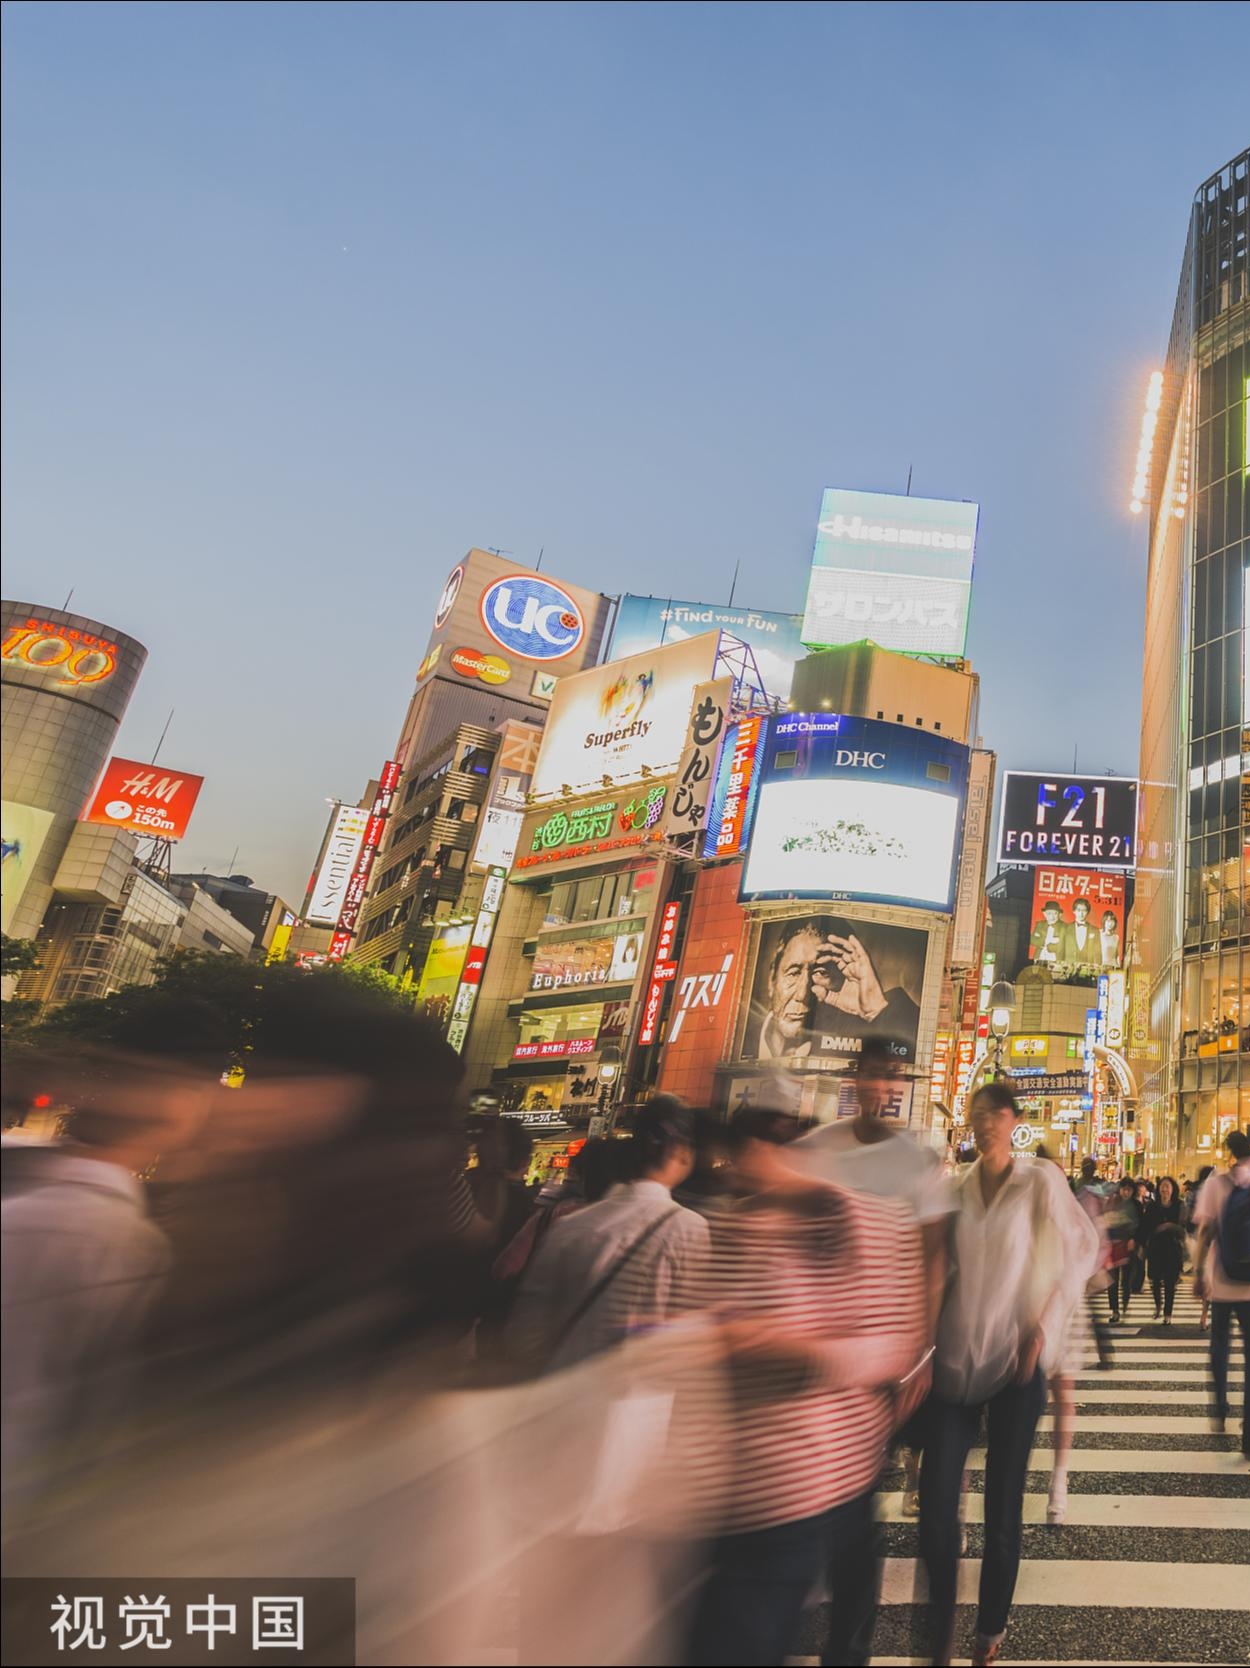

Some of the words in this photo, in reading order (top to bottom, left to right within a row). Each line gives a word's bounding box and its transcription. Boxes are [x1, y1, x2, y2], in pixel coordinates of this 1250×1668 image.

[494, 586, 573, 645] UC
[25, 618, 118, 655] SHIBUYA
[453, 654, 511, 678] MasterCard
[584, 720, 652, 749] Superfly
[776, 724, 798, 735] DHC
[798, 721, 839, 733] Channel
[672, 696, 724, 827] もんじゃ
[835, 750, 886, 769] DHC
[120, 771, 184, 804] H&M
[716, 721, 753, 846] 三千里薬品
[136, 804, 167, 818] この先
[1036, 783, 1105, 829] F21
[132, 812, 175, 831] 150m
[566, 813, 613, 844] 西村
[1006, 831, 1104, 857] FOREVER
[1109, 836, 1131, 858] 21
[832, 892, 852, 900] DHC
[1038, 871, 1122, 898] 日本ダービー
[533, 968, 605, 989] Euphoria
[668, 953, 734, 1043] クスリ
